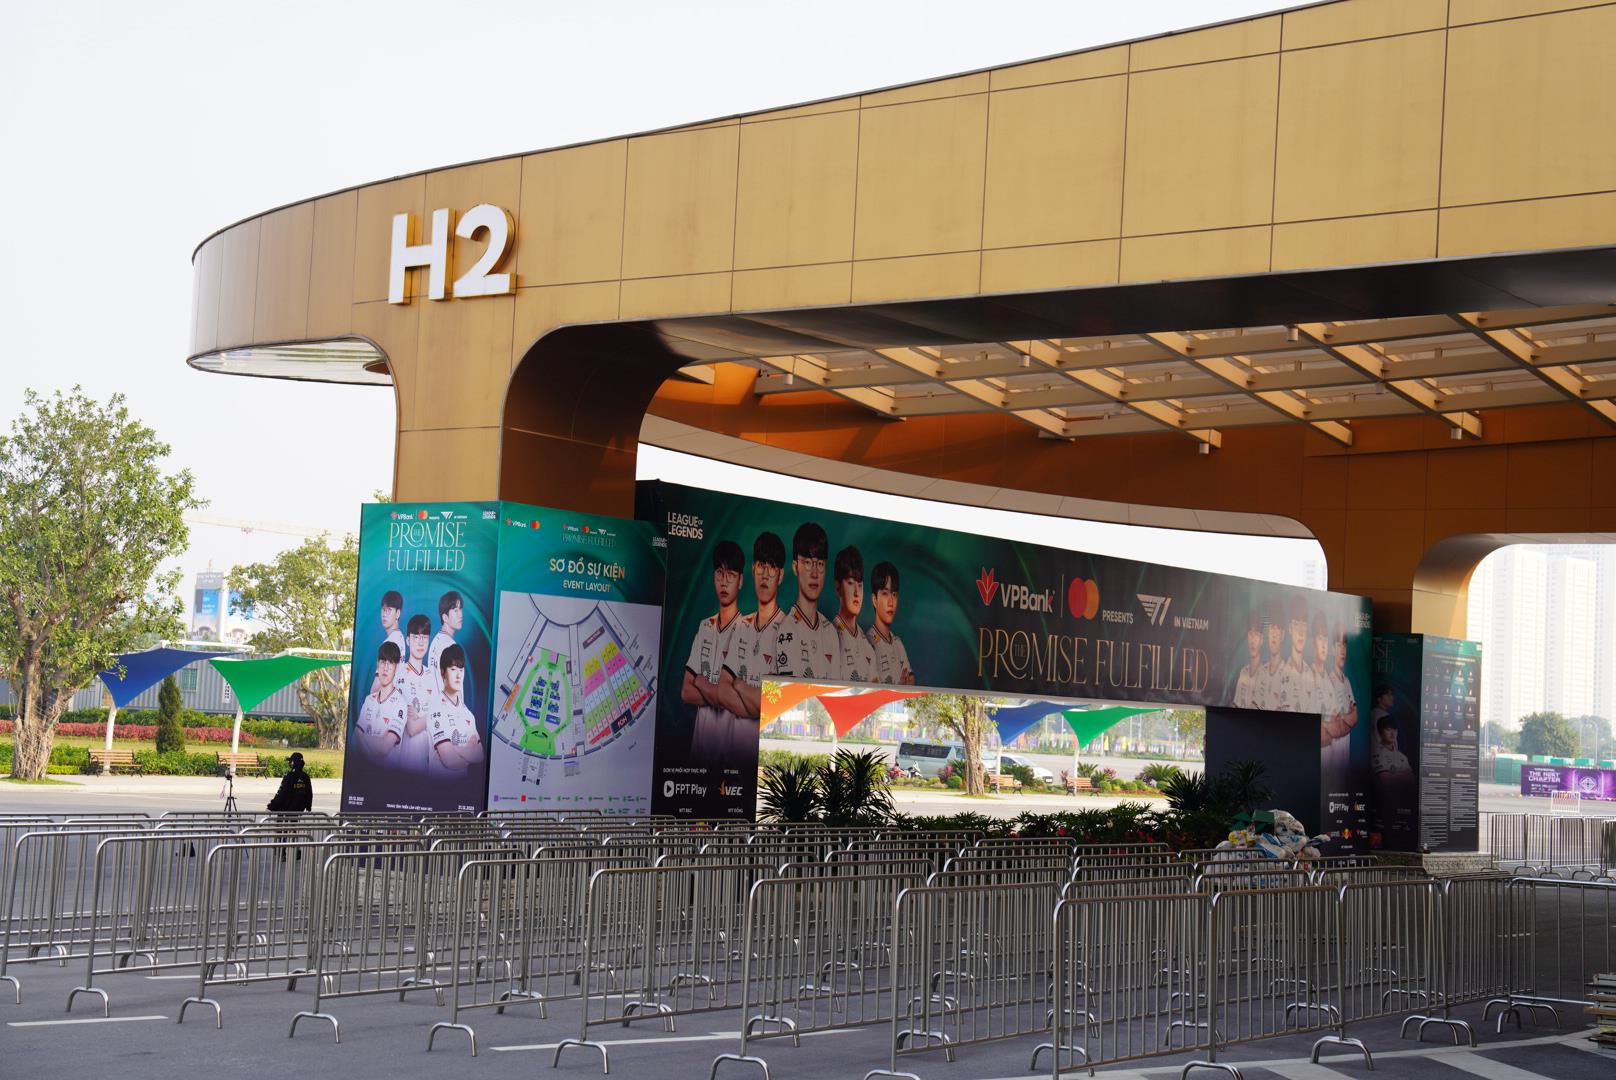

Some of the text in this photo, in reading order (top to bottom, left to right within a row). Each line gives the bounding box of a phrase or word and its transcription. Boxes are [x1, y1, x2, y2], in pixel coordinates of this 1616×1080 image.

[388, 203, 511, 304] H2
[667, 511, 699, 528] LEAGUE
[389, 521, 467, 548] PROMISE
[667, 524, 704, 540] LEGENDS
[387, 549, 465, 571] FULFILLED
[550, 556, 626, 582] SƠ ĐỒ SỰ KIỆN
[563, 579, 611, 593] EVENT LAYOUT
[1001, 583, 1053, 614] VPBank
[1102, 609, 1134, 625] PRESENTS
[1174, 615, 1182, 628] IN
[1182, 617, 1209, 631] VIETNAM
[977, 627, 1210, 693] PROMISE FULFILLED
[675, 783, 707, 798] FPT Play
[725, 786, 743, 796] VEC
